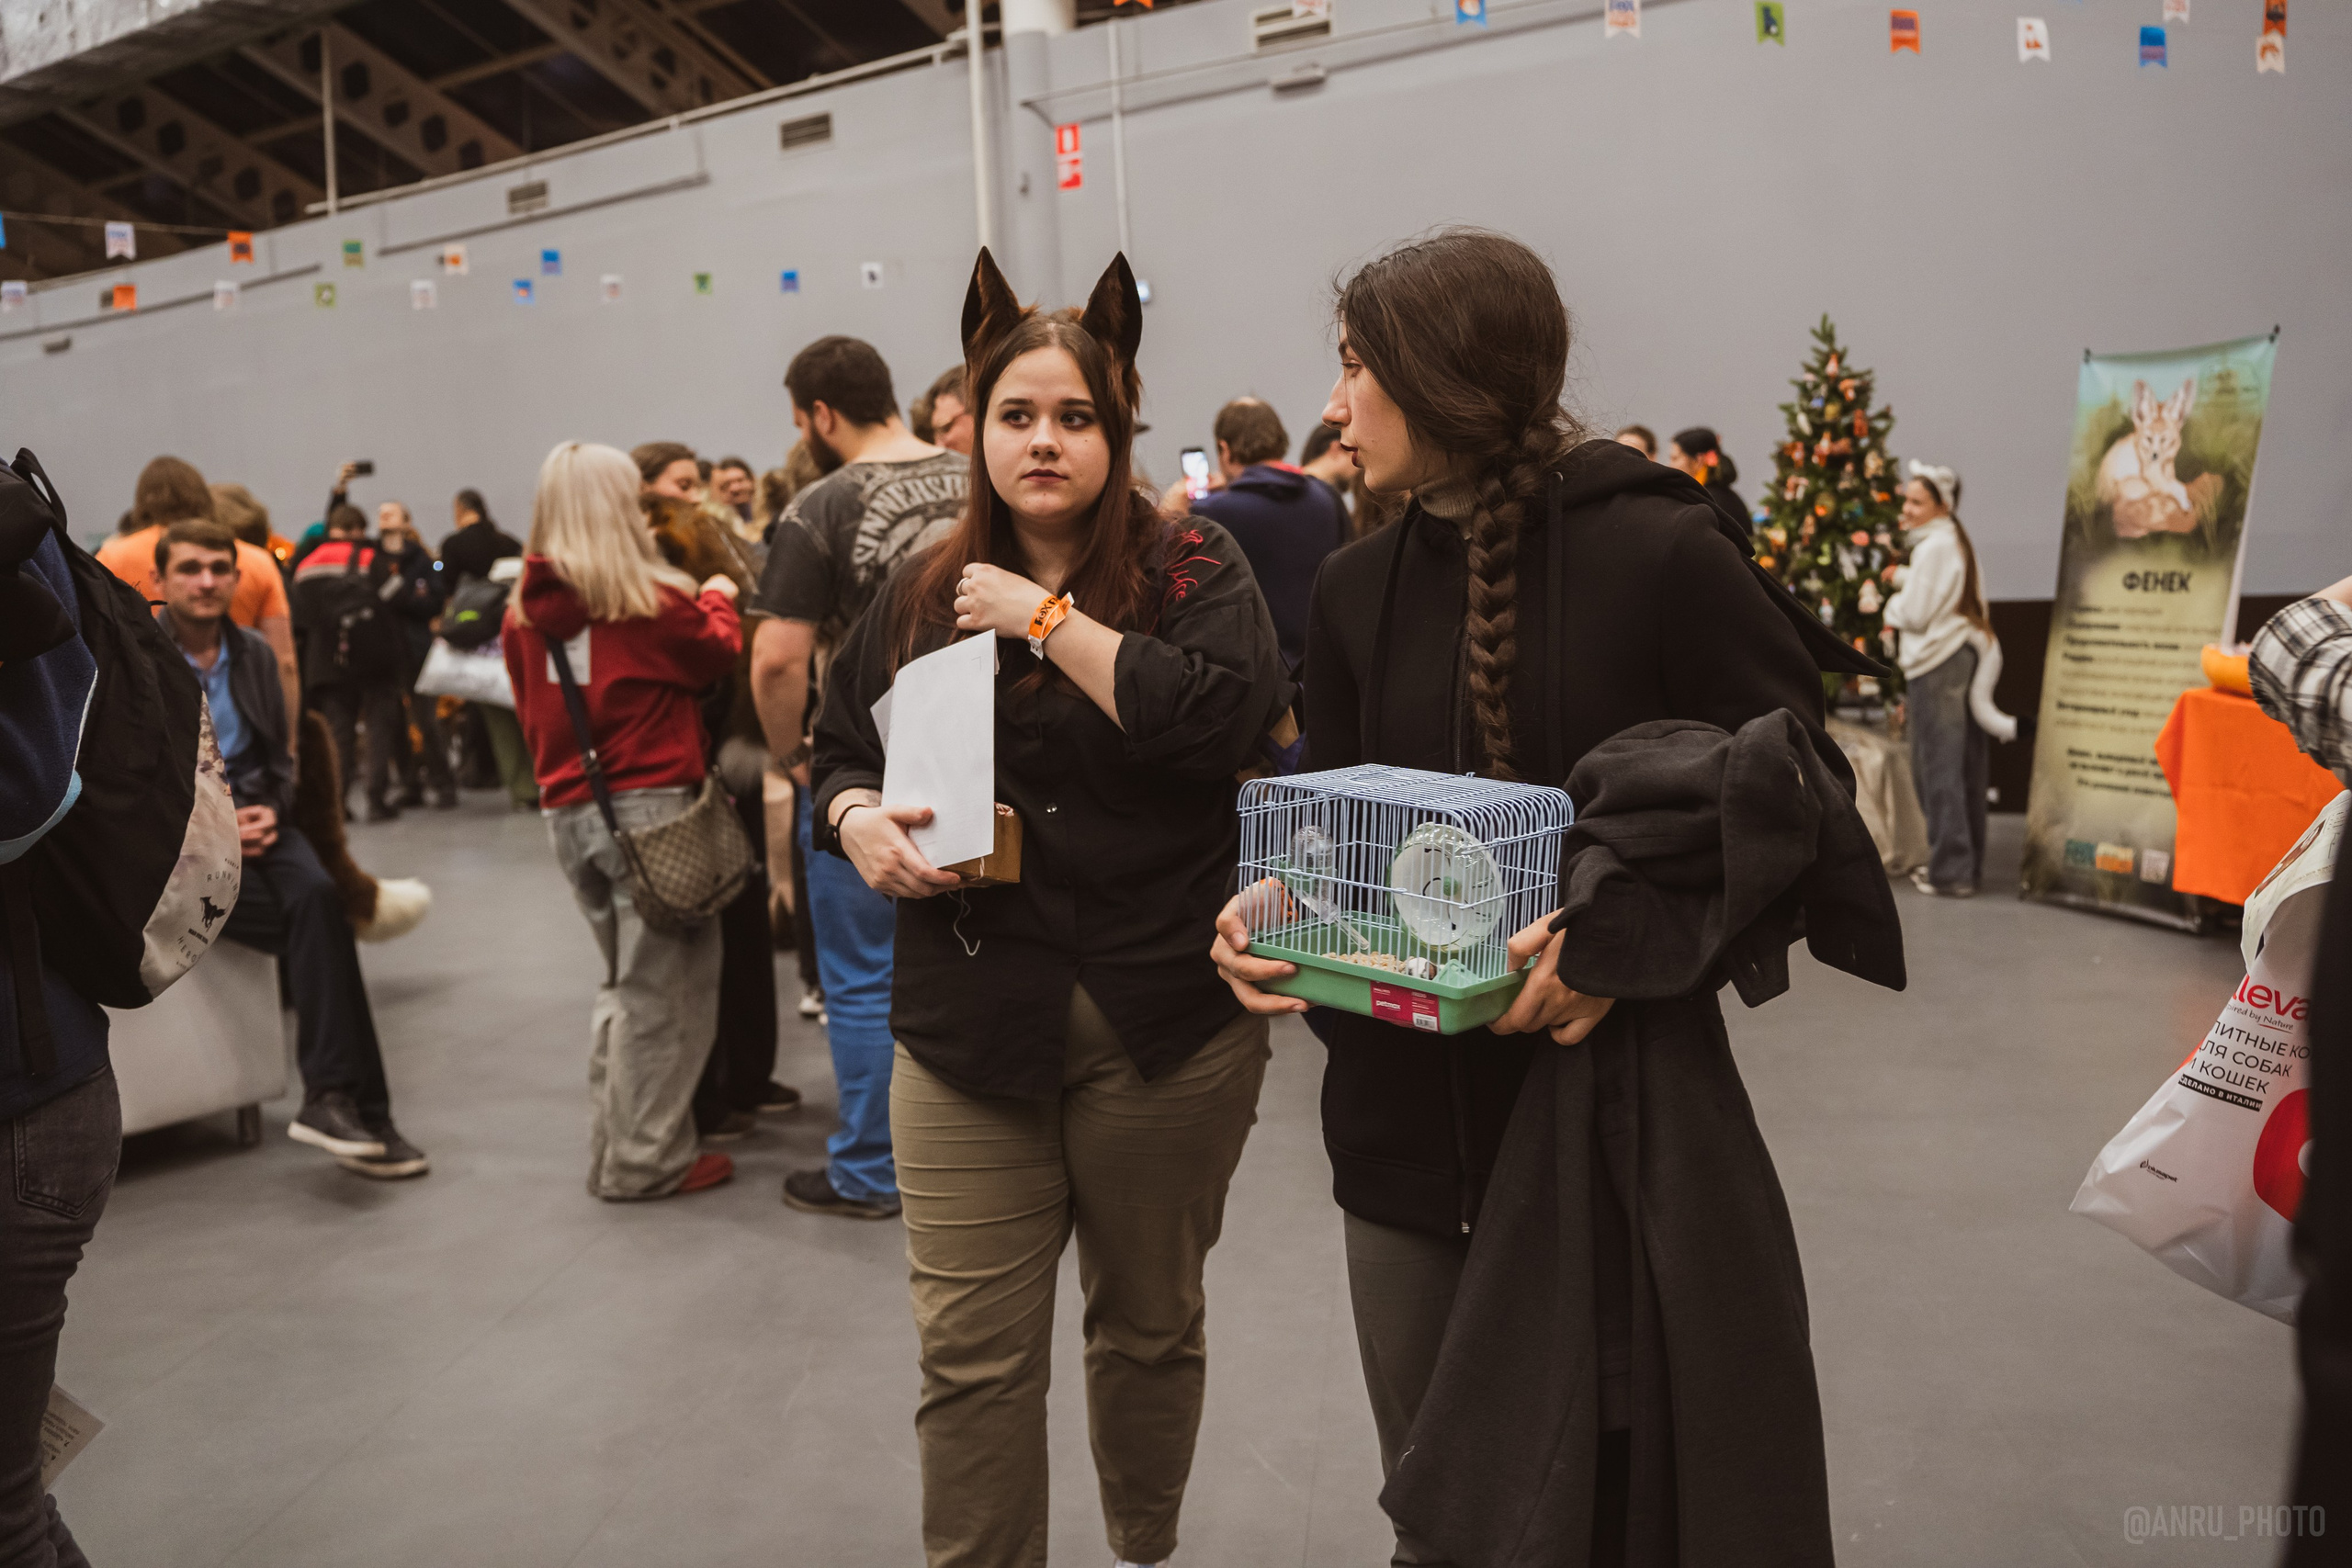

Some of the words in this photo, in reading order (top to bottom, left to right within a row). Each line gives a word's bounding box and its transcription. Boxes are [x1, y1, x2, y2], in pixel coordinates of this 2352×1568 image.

[2122, 571, 2192, 592] ФЕНЕК
[177, 935, 201, 964] HERO
[2233, 974, 2310, 1022] leva
[2263, 1015, 2294, 1031] Nature
[2199, 1039, 2228, 1060] ЛЯ
[2232, 1051, 2293, 1077] СОБАК
[2199, 1060, 2270, 1094] КОШЕК
